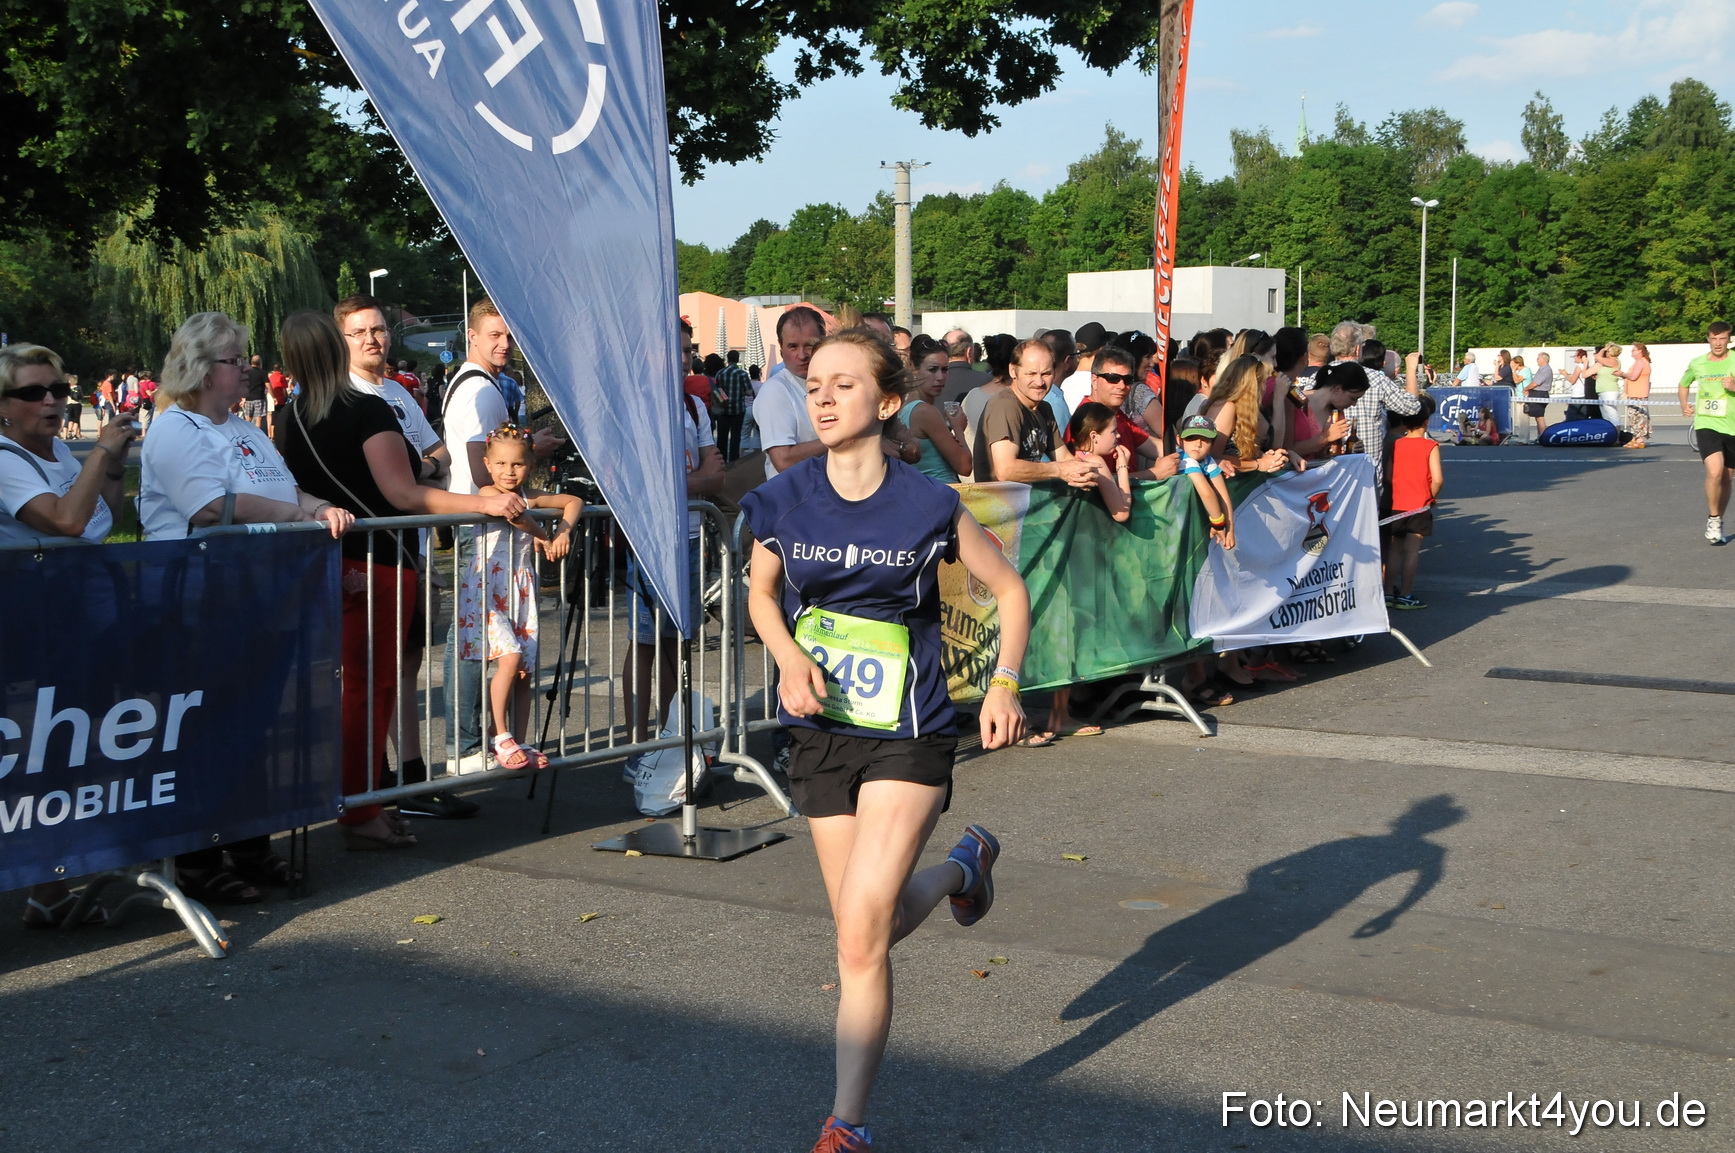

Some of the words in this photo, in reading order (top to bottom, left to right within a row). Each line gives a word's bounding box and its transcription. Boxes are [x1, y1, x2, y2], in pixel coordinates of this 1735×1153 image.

[1704, 399, 1719, 411] 36
[1560, 432, 1608, 443] Fischer
[793, 543, 842, 562] EURO
[861, 549, 917, 567] POLES
